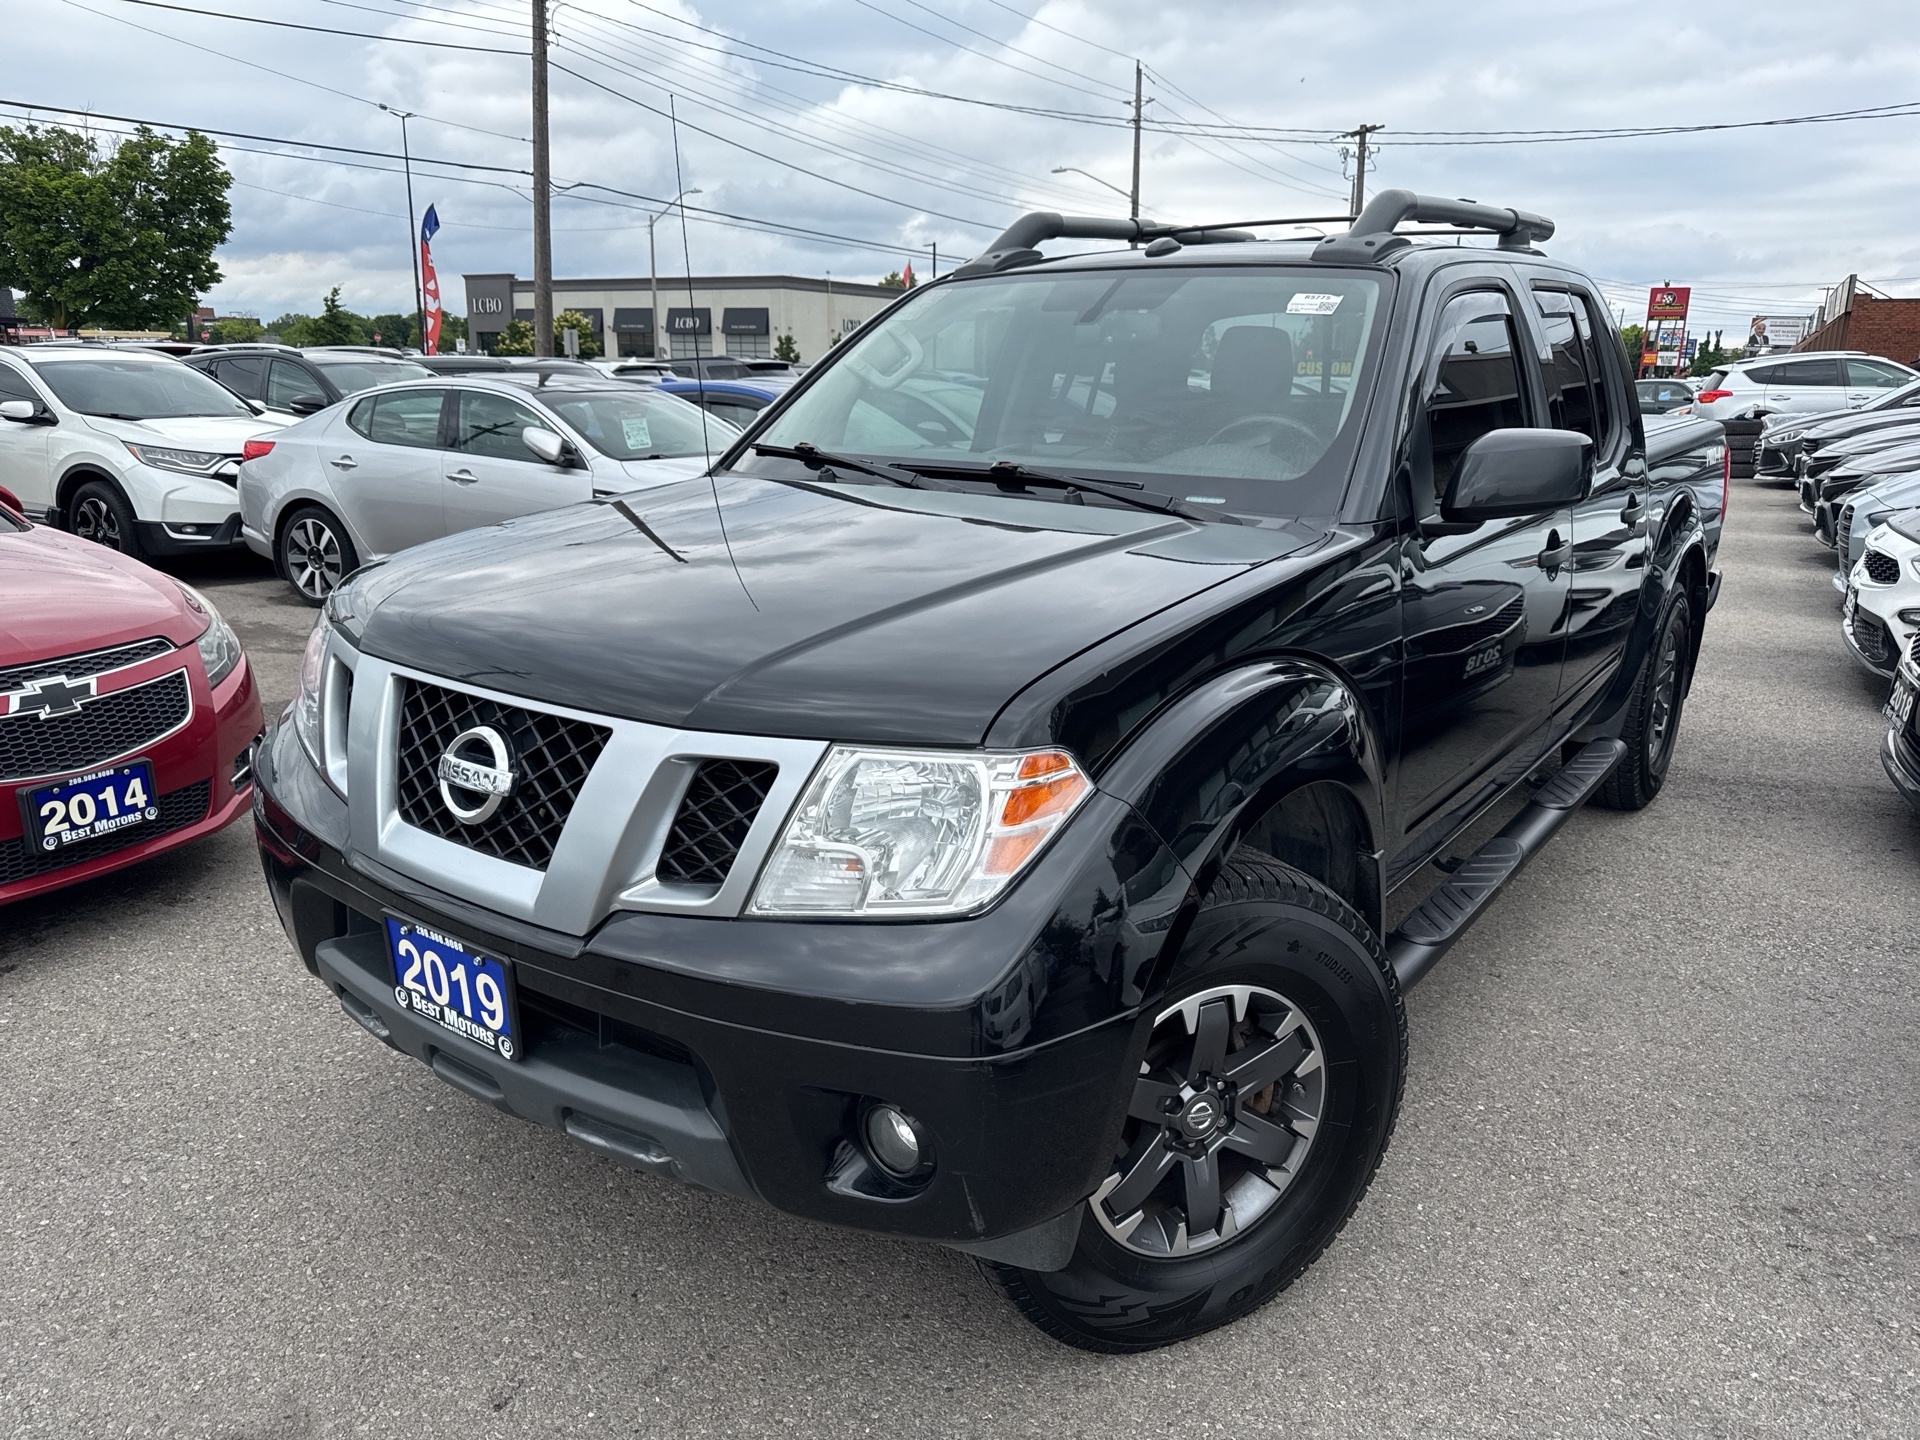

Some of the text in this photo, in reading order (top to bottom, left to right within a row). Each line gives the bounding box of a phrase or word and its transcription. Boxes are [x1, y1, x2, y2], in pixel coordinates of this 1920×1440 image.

[472, 297, 503, 314] LCBO
[675, 317, 700, 329] LCBO
[1297, 362, 1352, 375] CUSOM
[1889, 680, 1913, 722] 2018
[439, 757, 498, 790] NISSAN
[40, 777, 148, 836] 2014
[61, 812, 143, 843] BEST MOTORS
[398, 938, 504, 1031] 2019
[1314, 951, 1354, 985] STUDLESS
[411, 991, 495, 1046] BEST MOTORS
